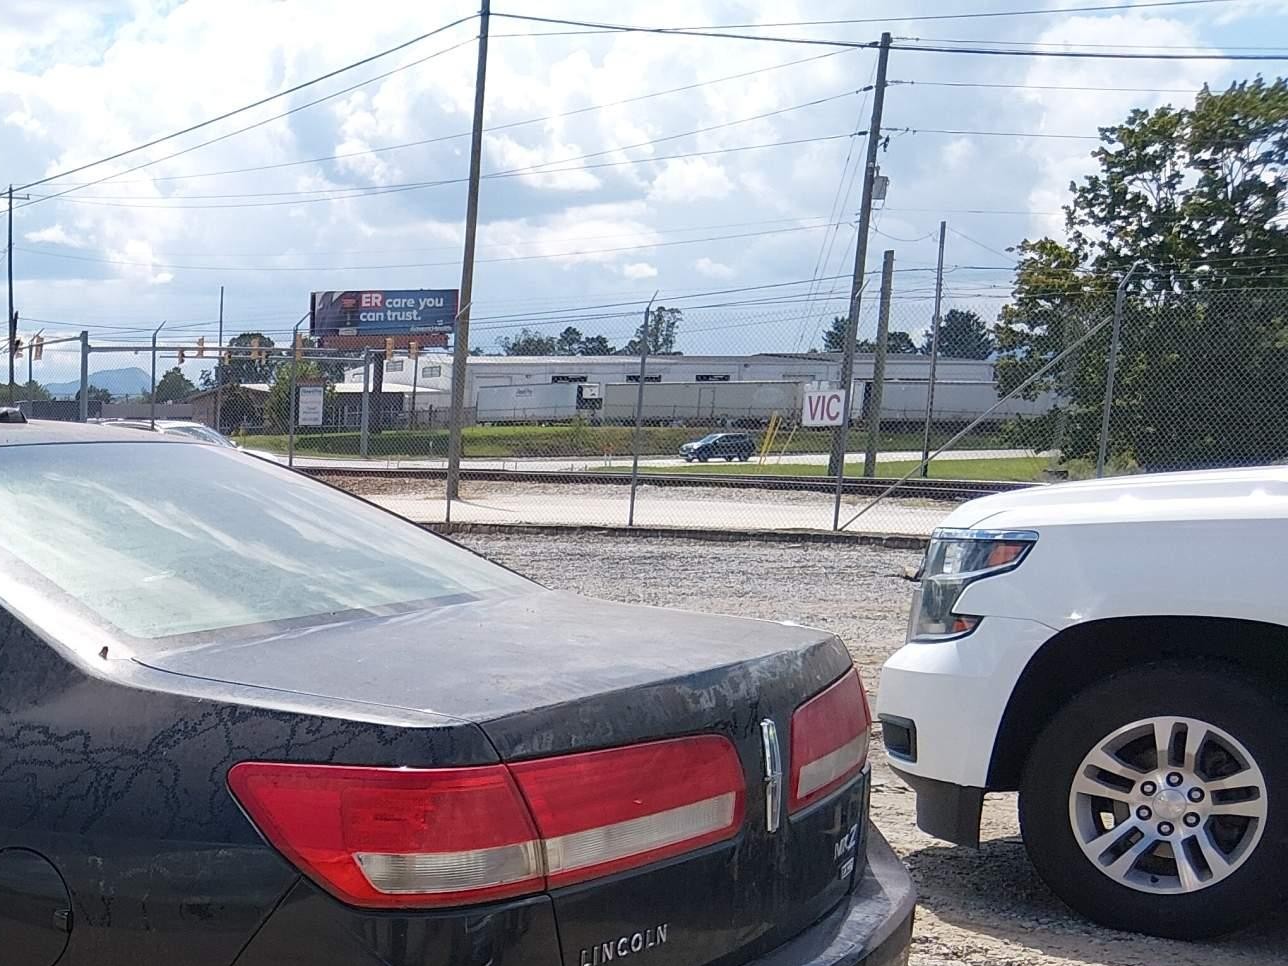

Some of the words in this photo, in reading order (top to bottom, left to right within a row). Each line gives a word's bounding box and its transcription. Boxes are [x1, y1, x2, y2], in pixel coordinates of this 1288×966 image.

[361, 293, 382, 307] ER
[385, 297, 415, 308] care
[419, 297, 444, 310] you
[359, 311, 384, 322] can
[386, 309, 422, 321] trust.
[808, 394, 840, 421] VIC
